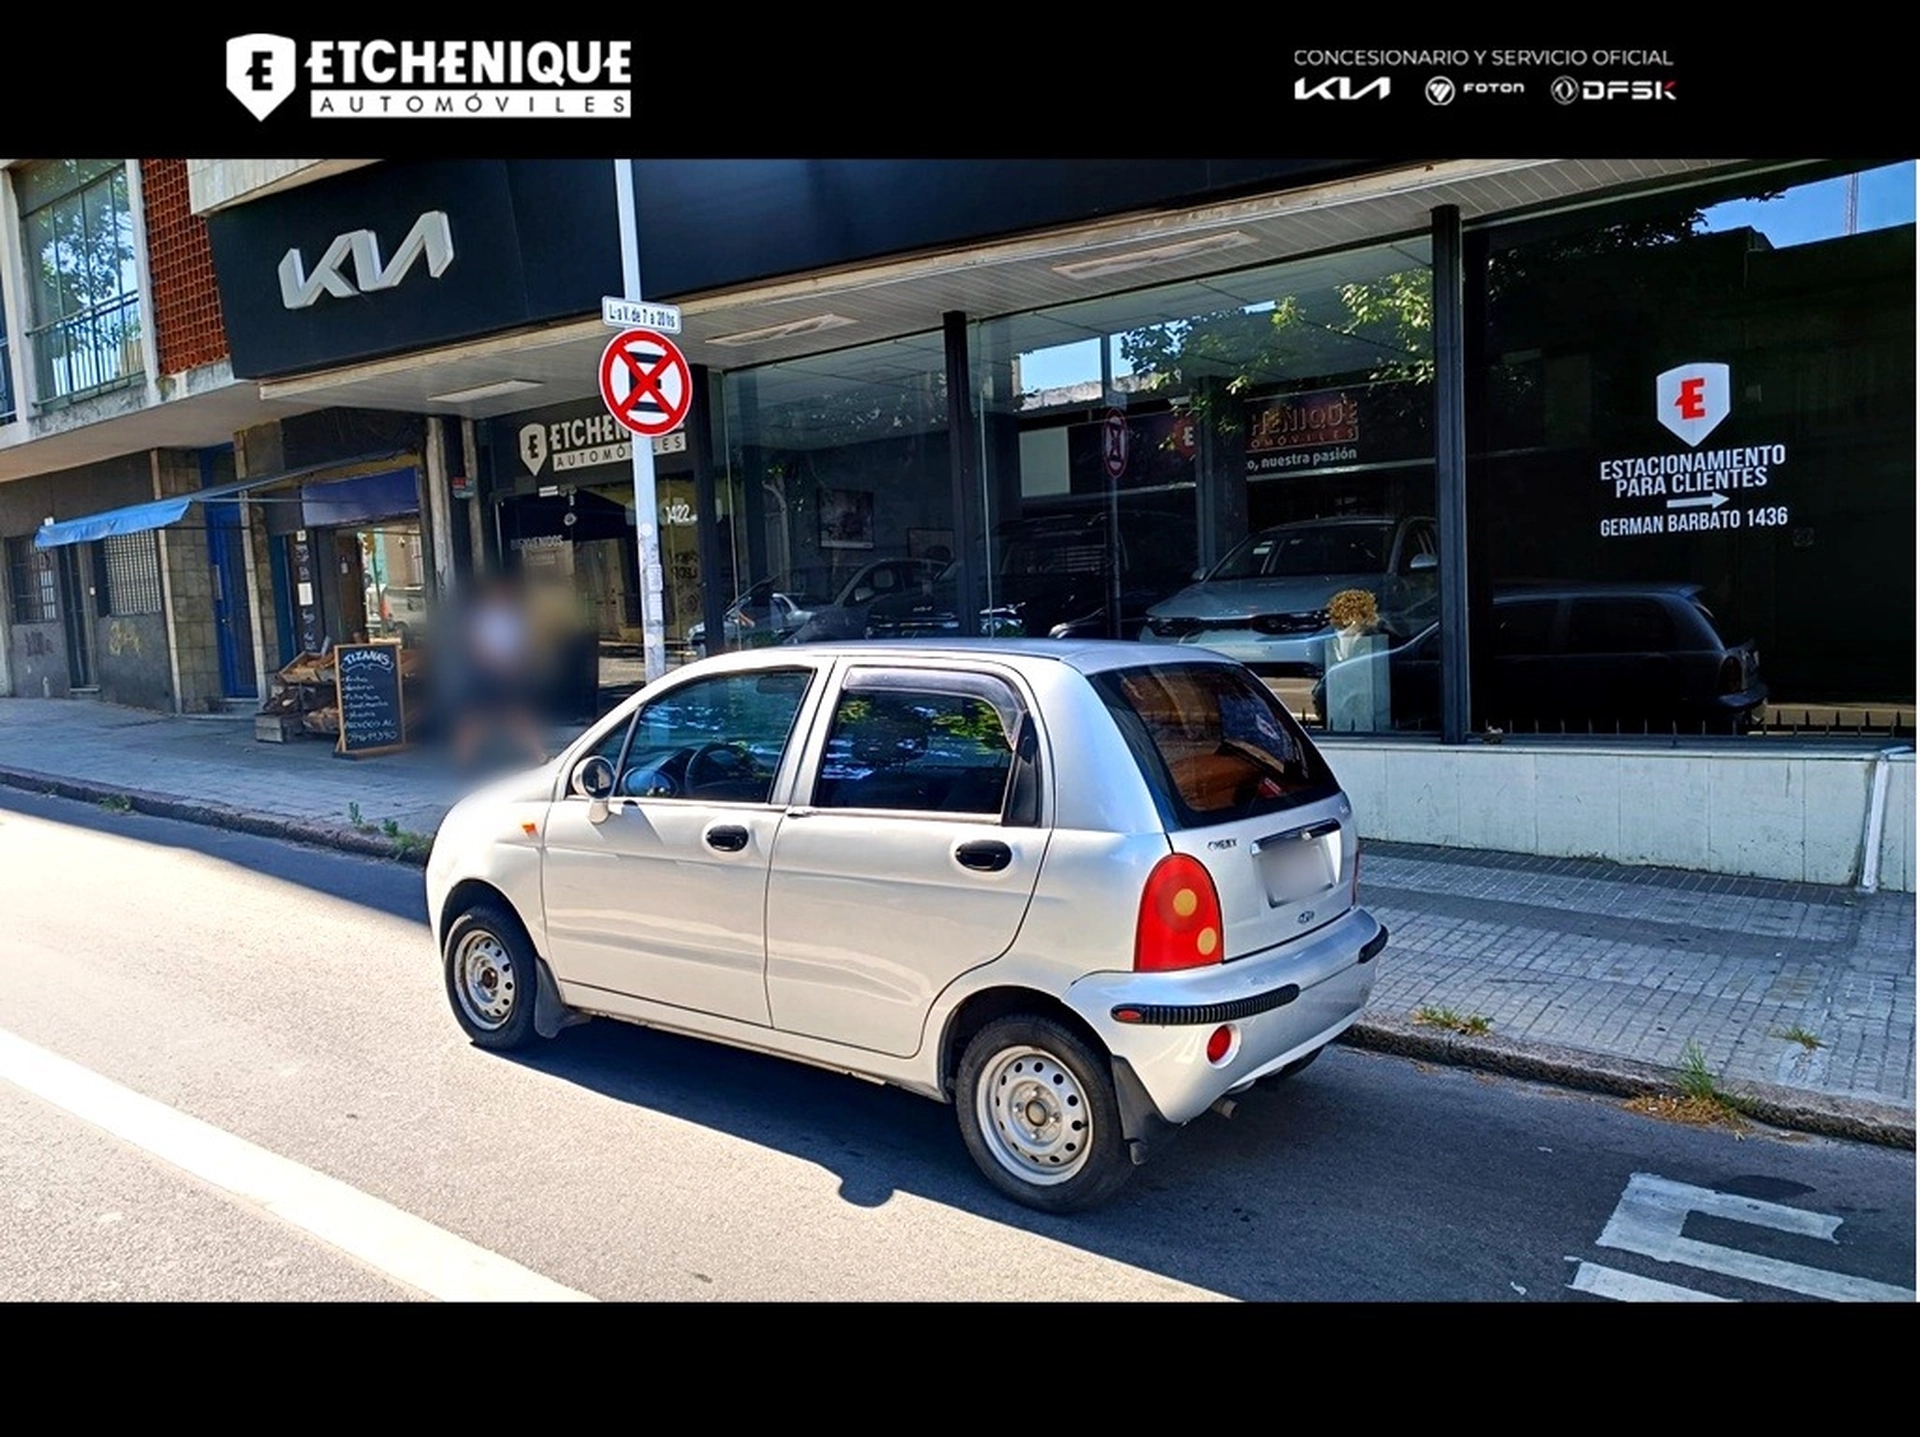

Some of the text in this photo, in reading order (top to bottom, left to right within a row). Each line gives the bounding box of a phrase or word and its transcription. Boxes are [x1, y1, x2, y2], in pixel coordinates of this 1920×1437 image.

[278, 210, 454, 309] KIA
[1674, 378, 1705, 420] E
[1251, 400, 1358, 437] HENIQUE
[556, 437, 682, 467] AUTOMÓES
[1261, 453, 1311, 469] nuestra
[1312, 446, 1358, 466] pasión
[1600, 444, 1786, 480] ESTACIONAMIENTO
[1616, 466, 1768, 498] PARA CLIENTES
[1601, 506, 1789, 537] GERMAN BARBATO 1436
